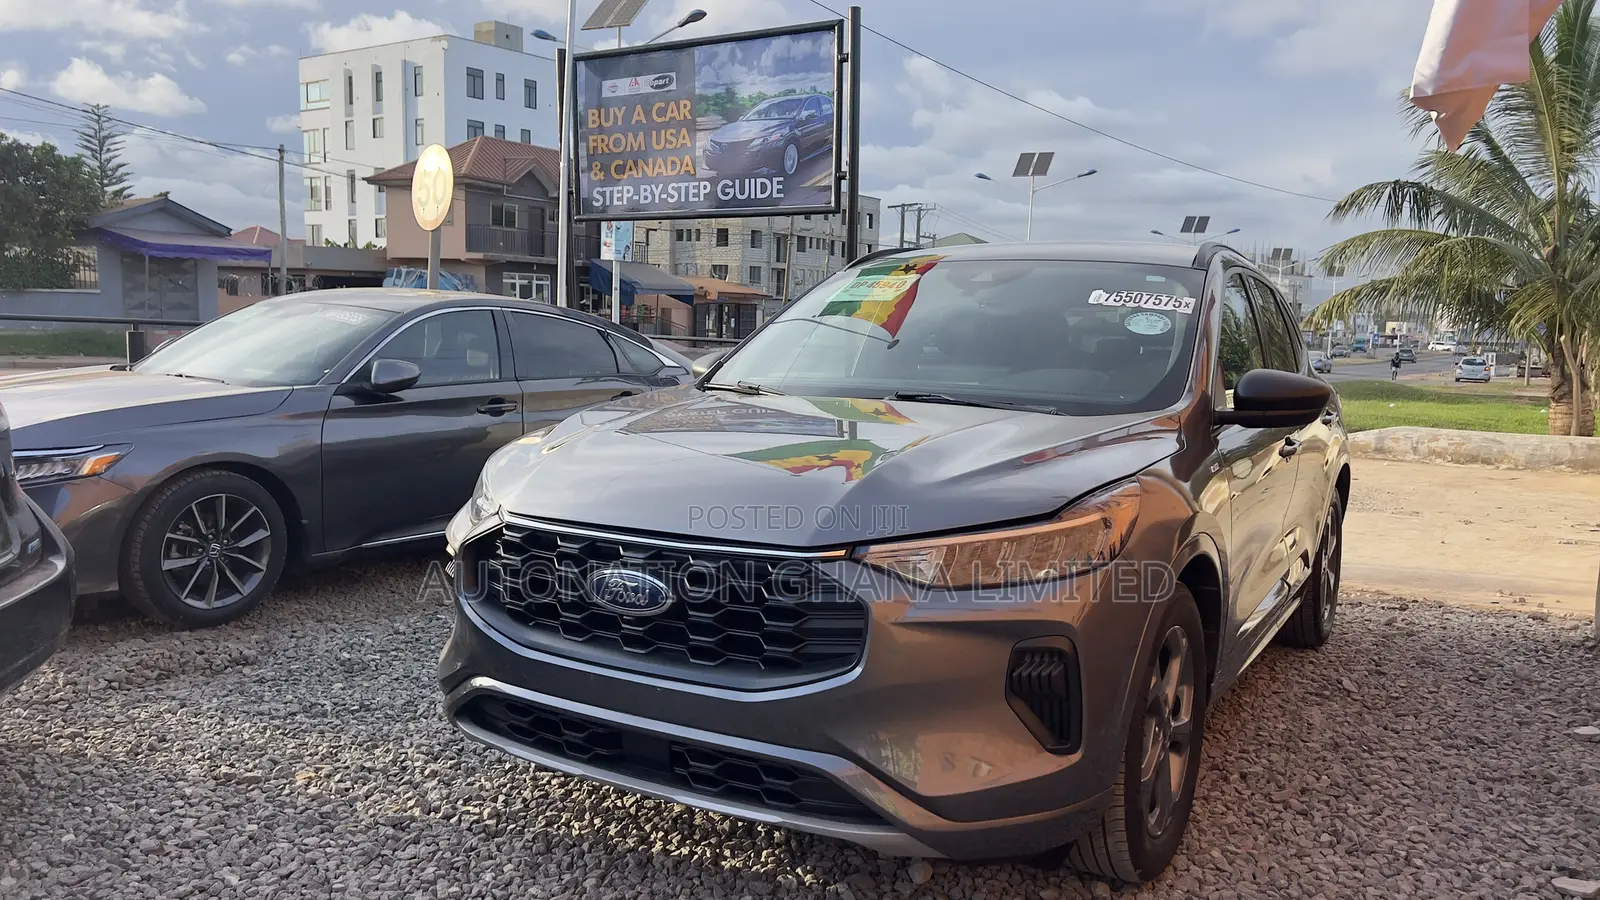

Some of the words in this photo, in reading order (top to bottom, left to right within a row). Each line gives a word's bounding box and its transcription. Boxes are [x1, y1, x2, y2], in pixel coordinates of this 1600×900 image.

[587, 105, 627, 129] BUY
[631, 103, 647, 125] A
[651, 99, 693, 123] CAR
[588, 131, 646, 155] FROM
[651, 127, 692, 150] USA
[590, 161, 605, 182] &
[610, 154, 697, 180] CANADA
[416, 169, 448, 207] 50
[592, 180, 711, 208] STEP-BY-STEP
[716, 176, 785, 201] GUIDE
[605, 578, 650, 606] Ford
